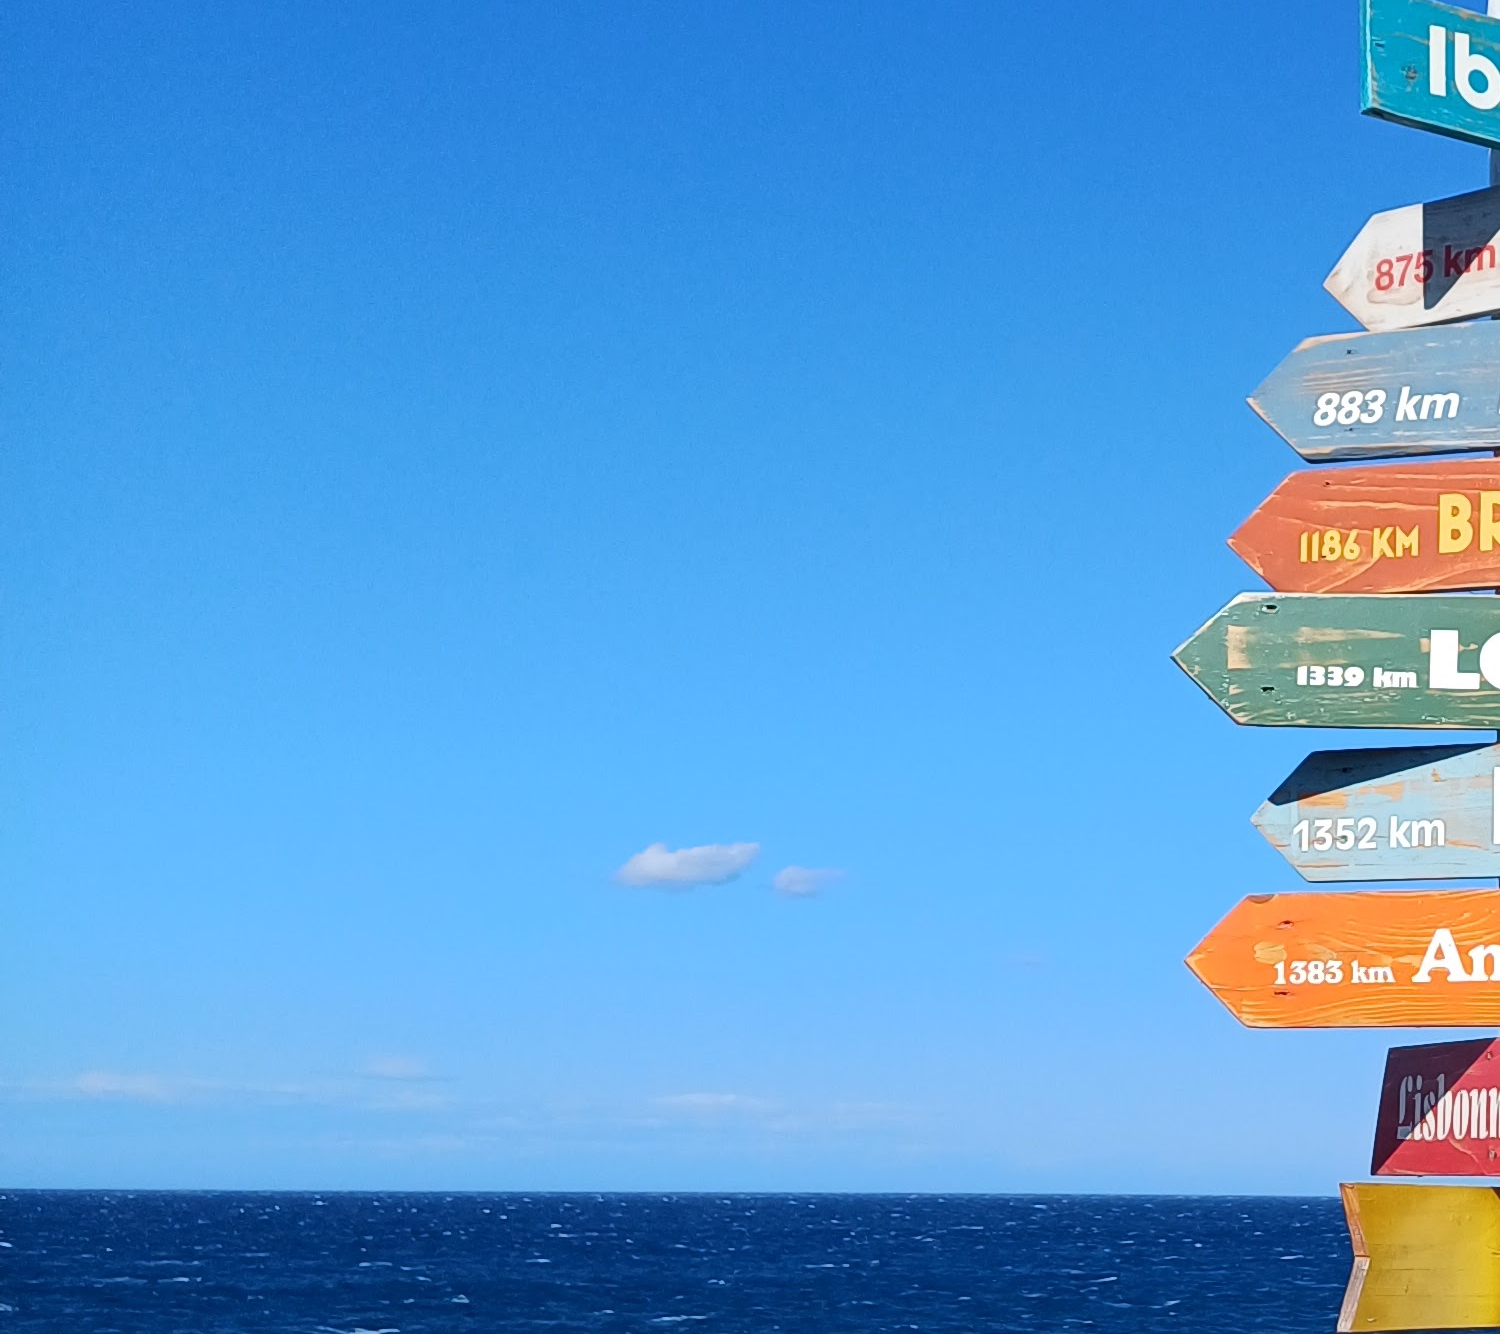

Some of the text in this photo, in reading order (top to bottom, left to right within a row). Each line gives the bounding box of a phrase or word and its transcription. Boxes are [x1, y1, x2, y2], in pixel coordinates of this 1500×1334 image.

[1374, 249, 1434, 291] 875
[1443, 244, 1496, 278] km
[1313, 387, 1386, 428] 883
[1394, 384, 1460, 423] km
[1299, 526, 1361, 562] 1186
[1371, 524, 1419, 559] KM
[1297, 666, 1365, 688] 1339
[1372, 665, 1418, 689] km
[1292, 816, 1377, 852] 1352
[1389, 814, 1446, 850] km
[1274, 960, 1344, 986] 1383
[1351, 960, 1396, 985] km
